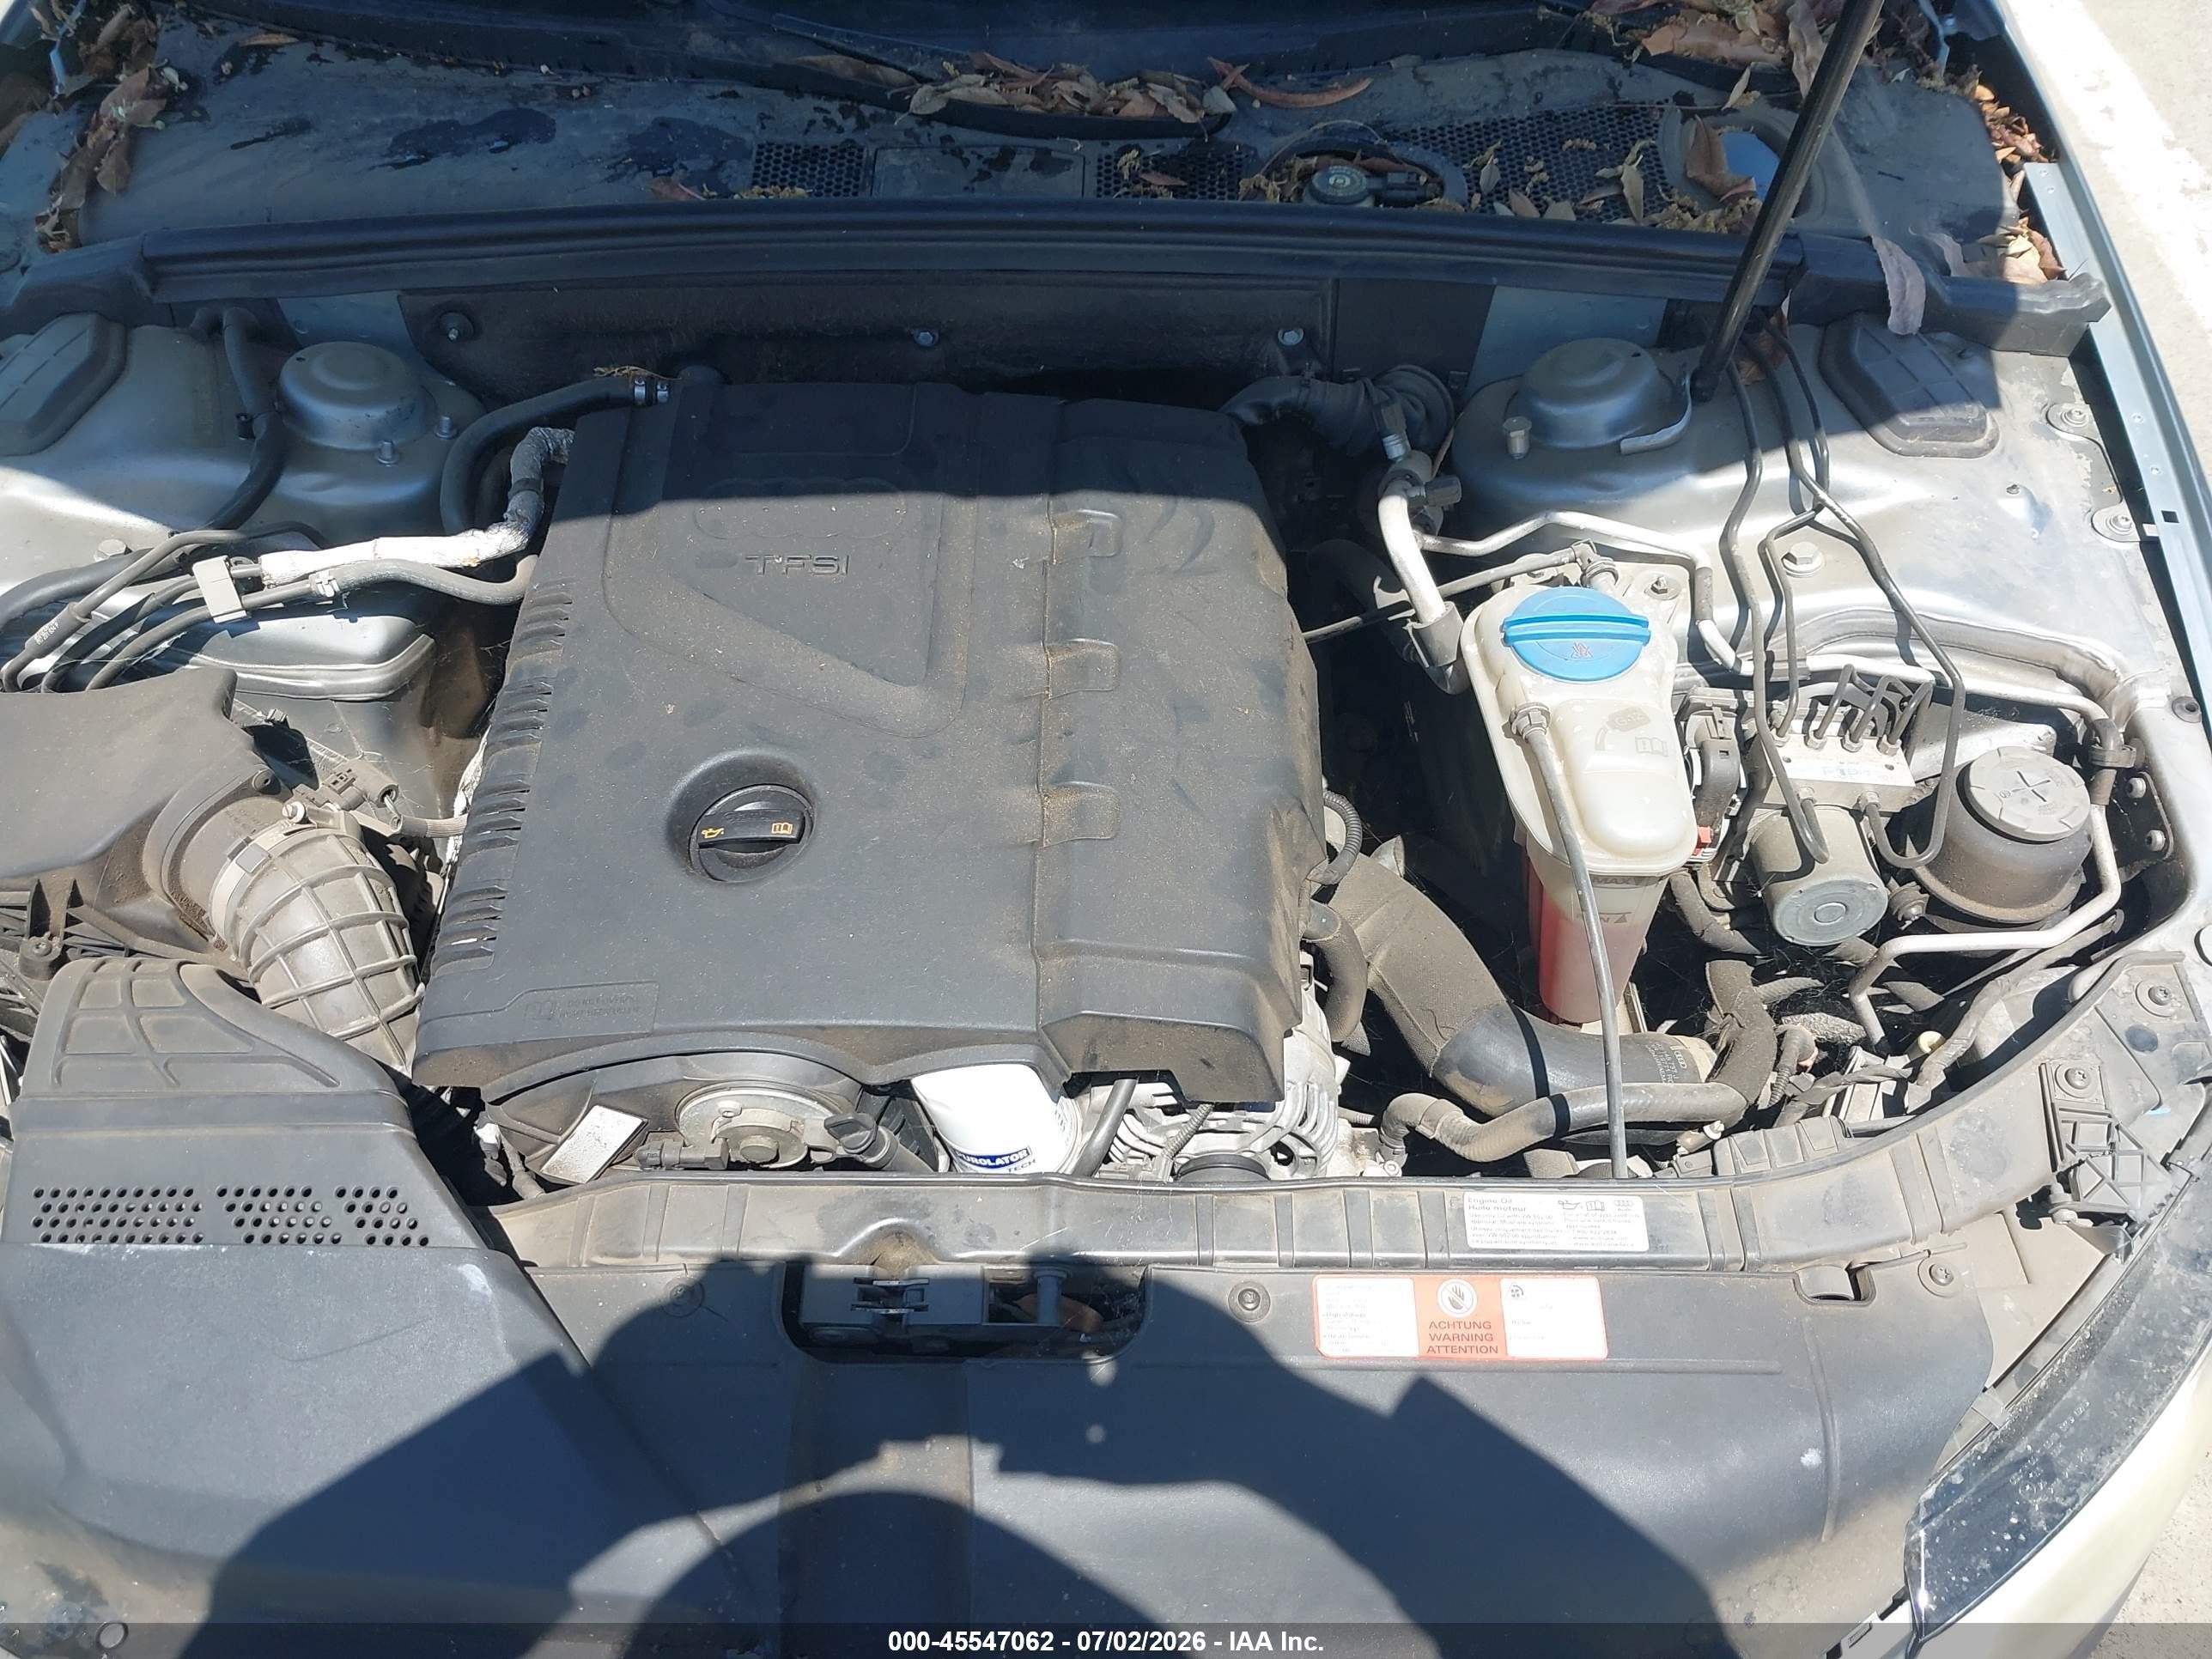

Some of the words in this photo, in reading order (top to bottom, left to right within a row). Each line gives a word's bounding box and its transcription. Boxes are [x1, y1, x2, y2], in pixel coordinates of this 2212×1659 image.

[744, 555, 849, 576] TFSI
[1007, 1158, 1036, 1173] TECH
[1468, 1196, 1498, 1205] Engine
[1429, 1321, 1492, 1329] ACHTUNG
[1429, 1333, 1493, 1341] WARNING
[1426, 1345, 1498, 1354] ATTENTION
